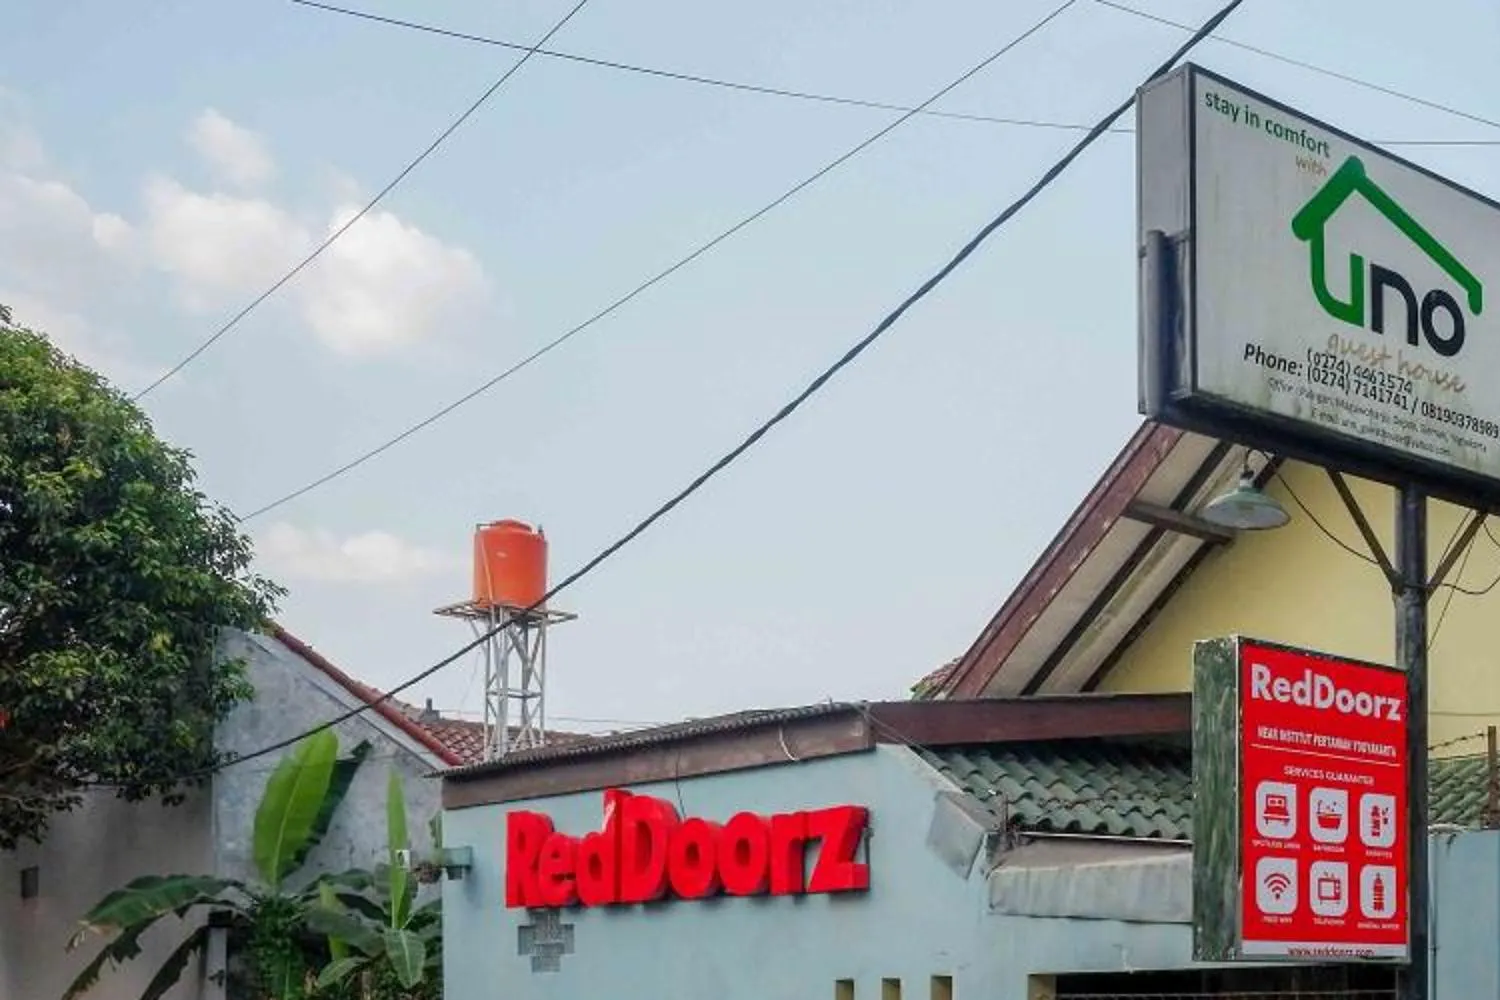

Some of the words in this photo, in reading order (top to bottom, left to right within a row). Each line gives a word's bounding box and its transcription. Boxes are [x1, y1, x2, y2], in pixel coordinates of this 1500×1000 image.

[1205, 92, 1240, 123] stay
[1245, 104, 1260, 128] in
[1265, 119, 1330, 157] comfort
[1296, 155, 1328, 177] with
[1244, 343, 1303, 377] Phone:
[1307, 364, 1351, 396] (0274)
[1354, 379, 1409, 411] 7141741
[1410, 396, 1419, 415] /
[1307, 348, 1351, 375] (0274)
[1327, 333, 1392, 367] guest
[1399, 348, 1466, 393] house
[1251, 663, 1402, 721] RedDoorz
[1284, 765, 1324, 780] SERVICES
[506, 787, 871, 909] RedDoorz
